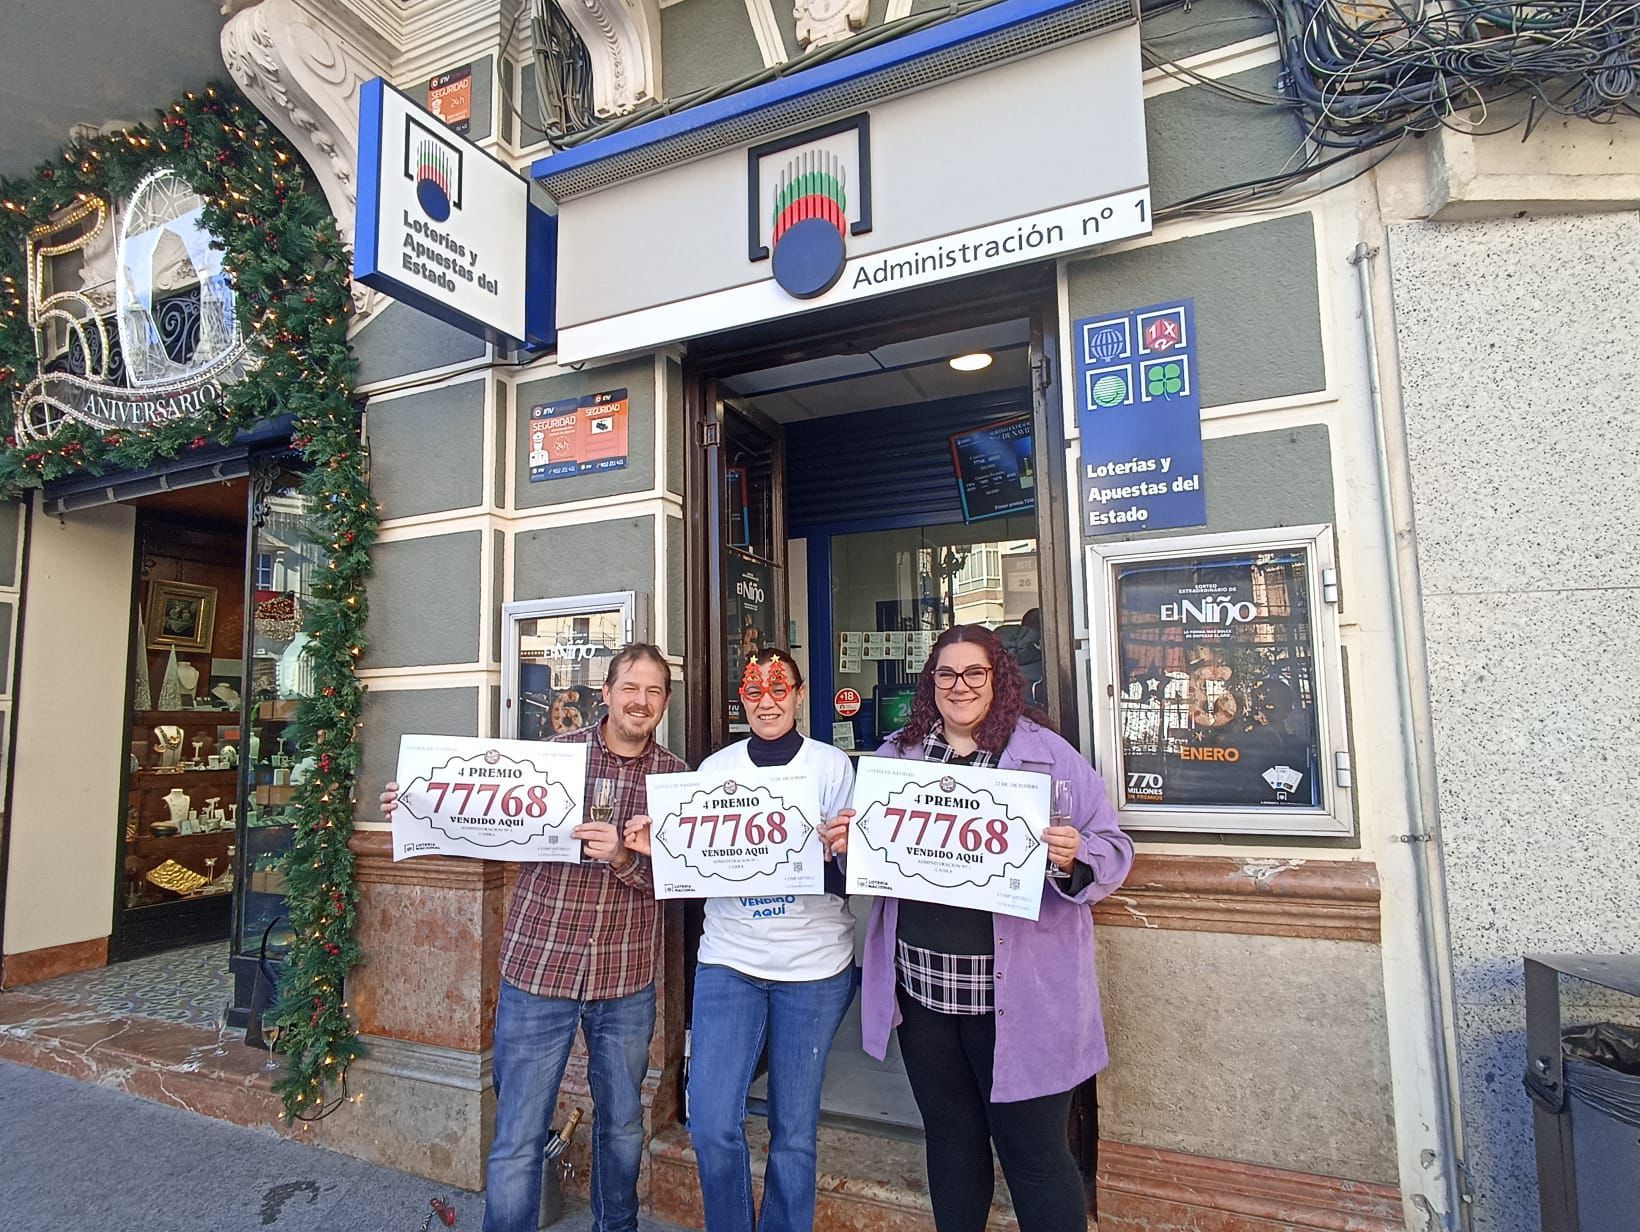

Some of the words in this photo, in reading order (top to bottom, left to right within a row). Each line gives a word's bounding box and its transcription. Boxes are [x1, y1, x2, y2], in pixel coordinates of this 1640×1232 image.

[403, 209, 466, 257] Loterías
[468, 250, 478, 267] y
[852, 223, 1063, 289] Administración
[1082, 207, 1113, 236] nº
[1134, 199, 1146, 223] 1
[402, 252, 456, 293] Estado
[403, 233, 474, 283] Apuestas
[477, 273, 498, 296] del
[84, 384, 217, 425] ANIVERSARIO
[585, 403, 620, 417] SEGURIDAD
[532, 416, 576, 431] SEGURIDAD
[1087, 457, 1156, 479] Loterías
[1161, 456, 1171, 473] y
[1088, 480, 1167, 504] Apuestas
[1172, 475, 1199, 492] del
[1090, 506, 1148, 525] Estado
[1181, 596, 1257, 626] Niño
[1180, 746, 1240, 762] ENERO
[468, 767, 523, 779] PREMIO
[1128, 772, 1163, 788] 770
[1128, 787, 1163, 795] MILLONES
[426, 782, 548, 819] 77768
[712, 796, 760, 809] PREMIO
[925, 794, 980, 811] PREMIO
[450, 816, 496, 826] VENDIDO
[498, 817, 525, 828] AQUÍ
[678, 811, 788, 849] 77768
[884, 807, 1009, 855] 77768
[702, 848, 743, 857] VENDIDO
[745, 845, 769, 857] AQUÍ
[906, 846, 954, 860] VENDIDO
[956, 852, 984, 864] AQUÍ
[739, 895, 796, 907] VENDIDO
[753, 904, 786, 918] AQUÍ
